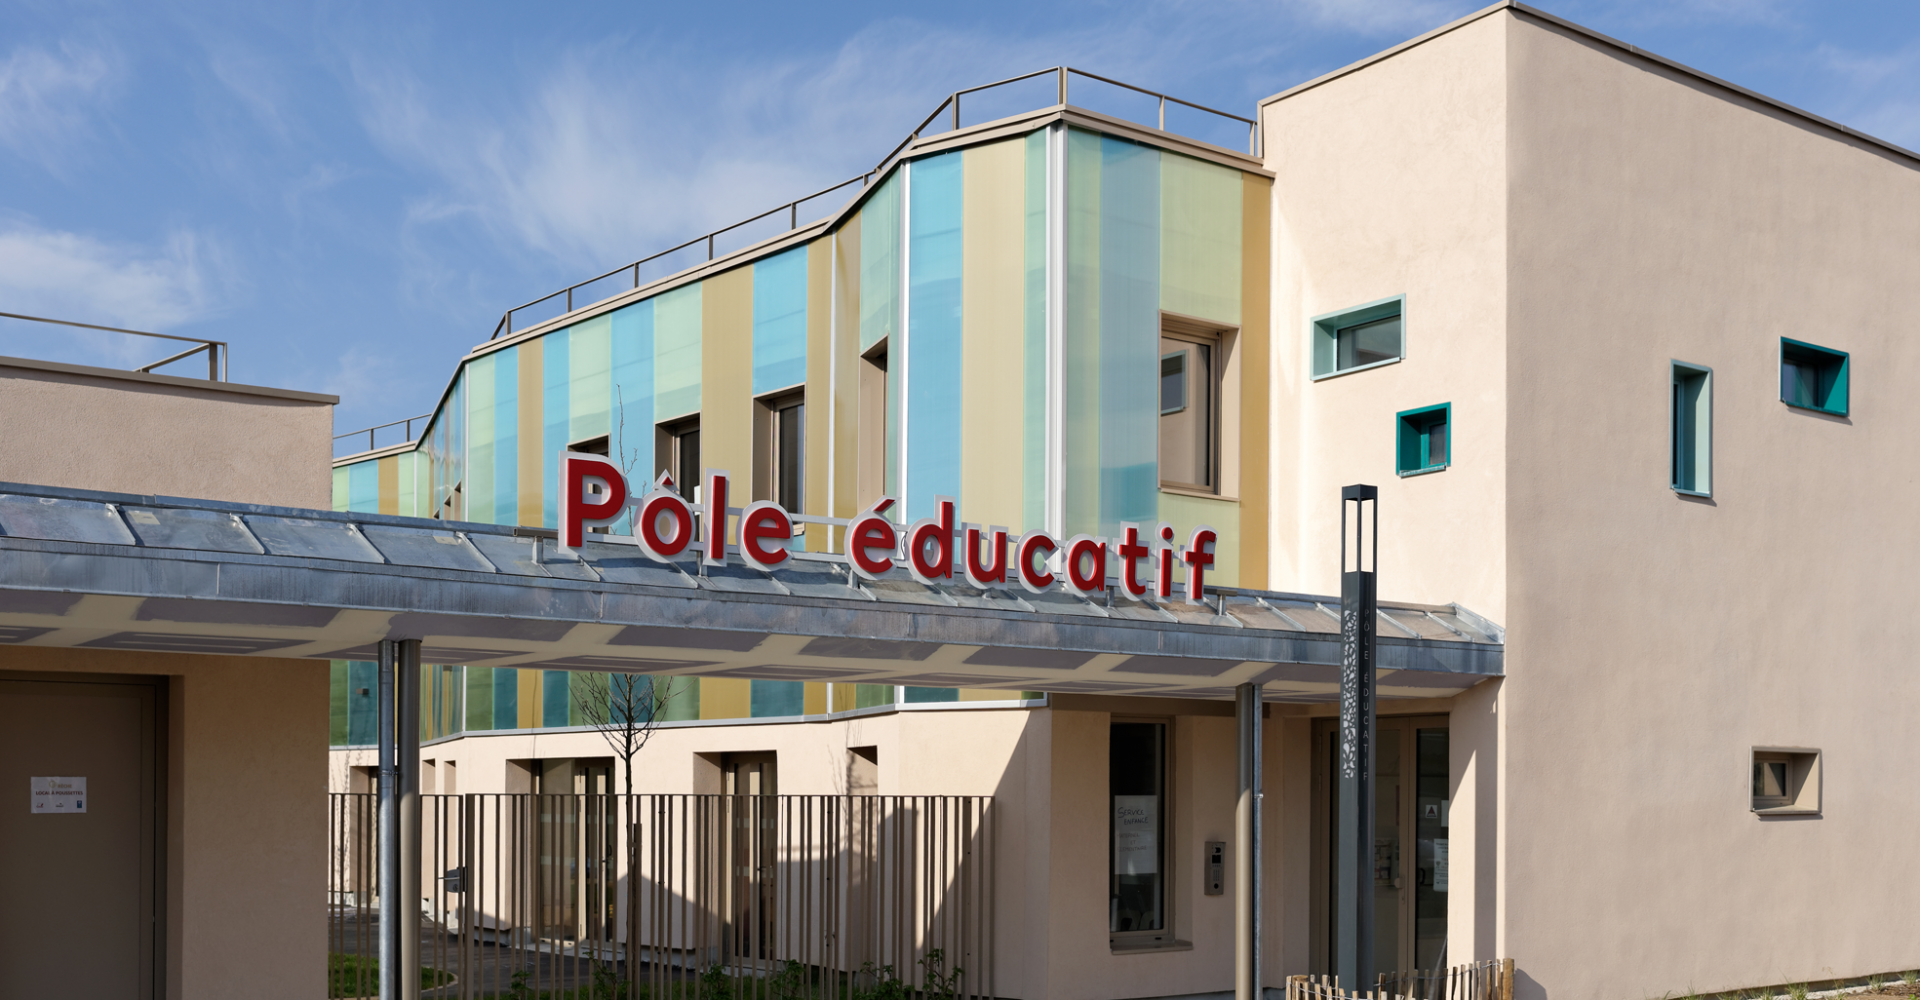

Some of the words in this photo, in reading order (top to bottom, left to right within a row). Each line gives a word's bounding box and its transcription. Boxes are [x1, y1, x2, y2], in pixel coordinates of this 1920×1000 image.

[561, 453, 793, 569] Pôle
[846, 496, 1217, 603] éducatif
[1362, 671, 1370, 781] ÉDUCATIF
